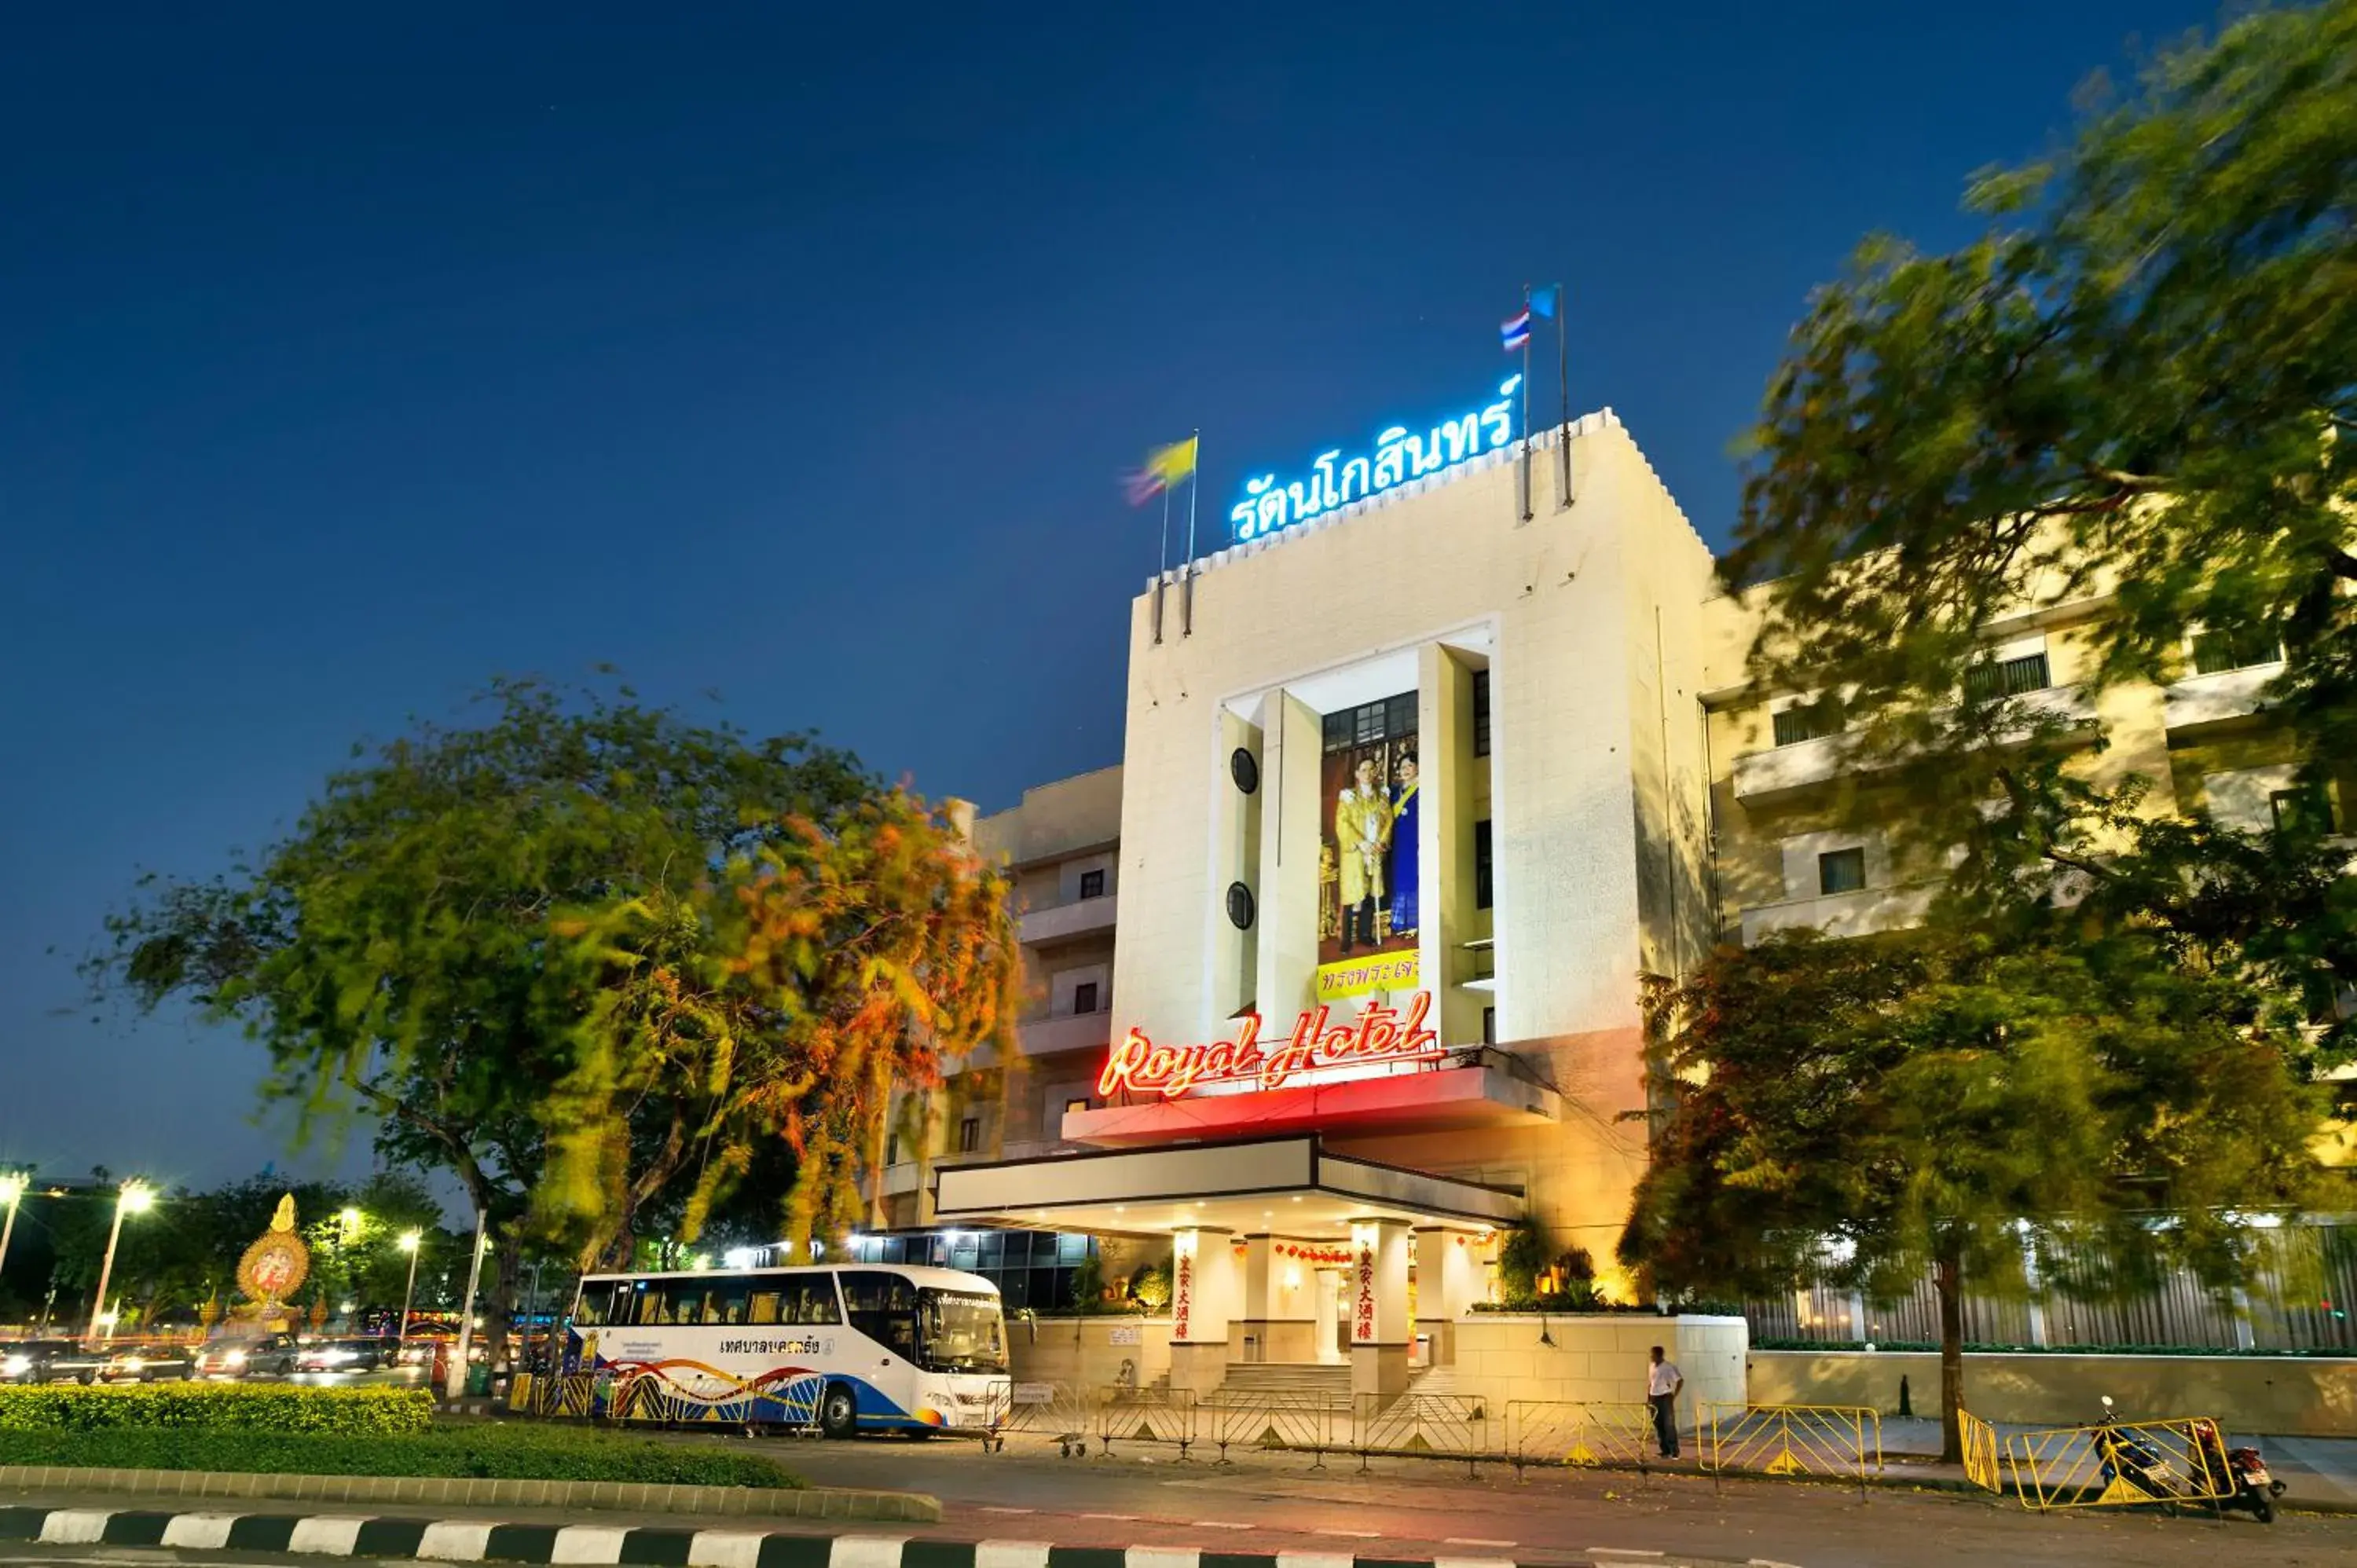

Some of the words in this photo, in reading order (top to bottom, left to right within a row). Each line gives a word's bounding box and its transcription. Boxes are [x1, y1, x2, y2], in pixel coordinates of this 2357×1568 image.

[1231, 373, 1521, 539] รัตนโกสินทร์
[1099, 1013, 1263, 1097] Royal
[1263, 991, 1438, 1087] Hotel
